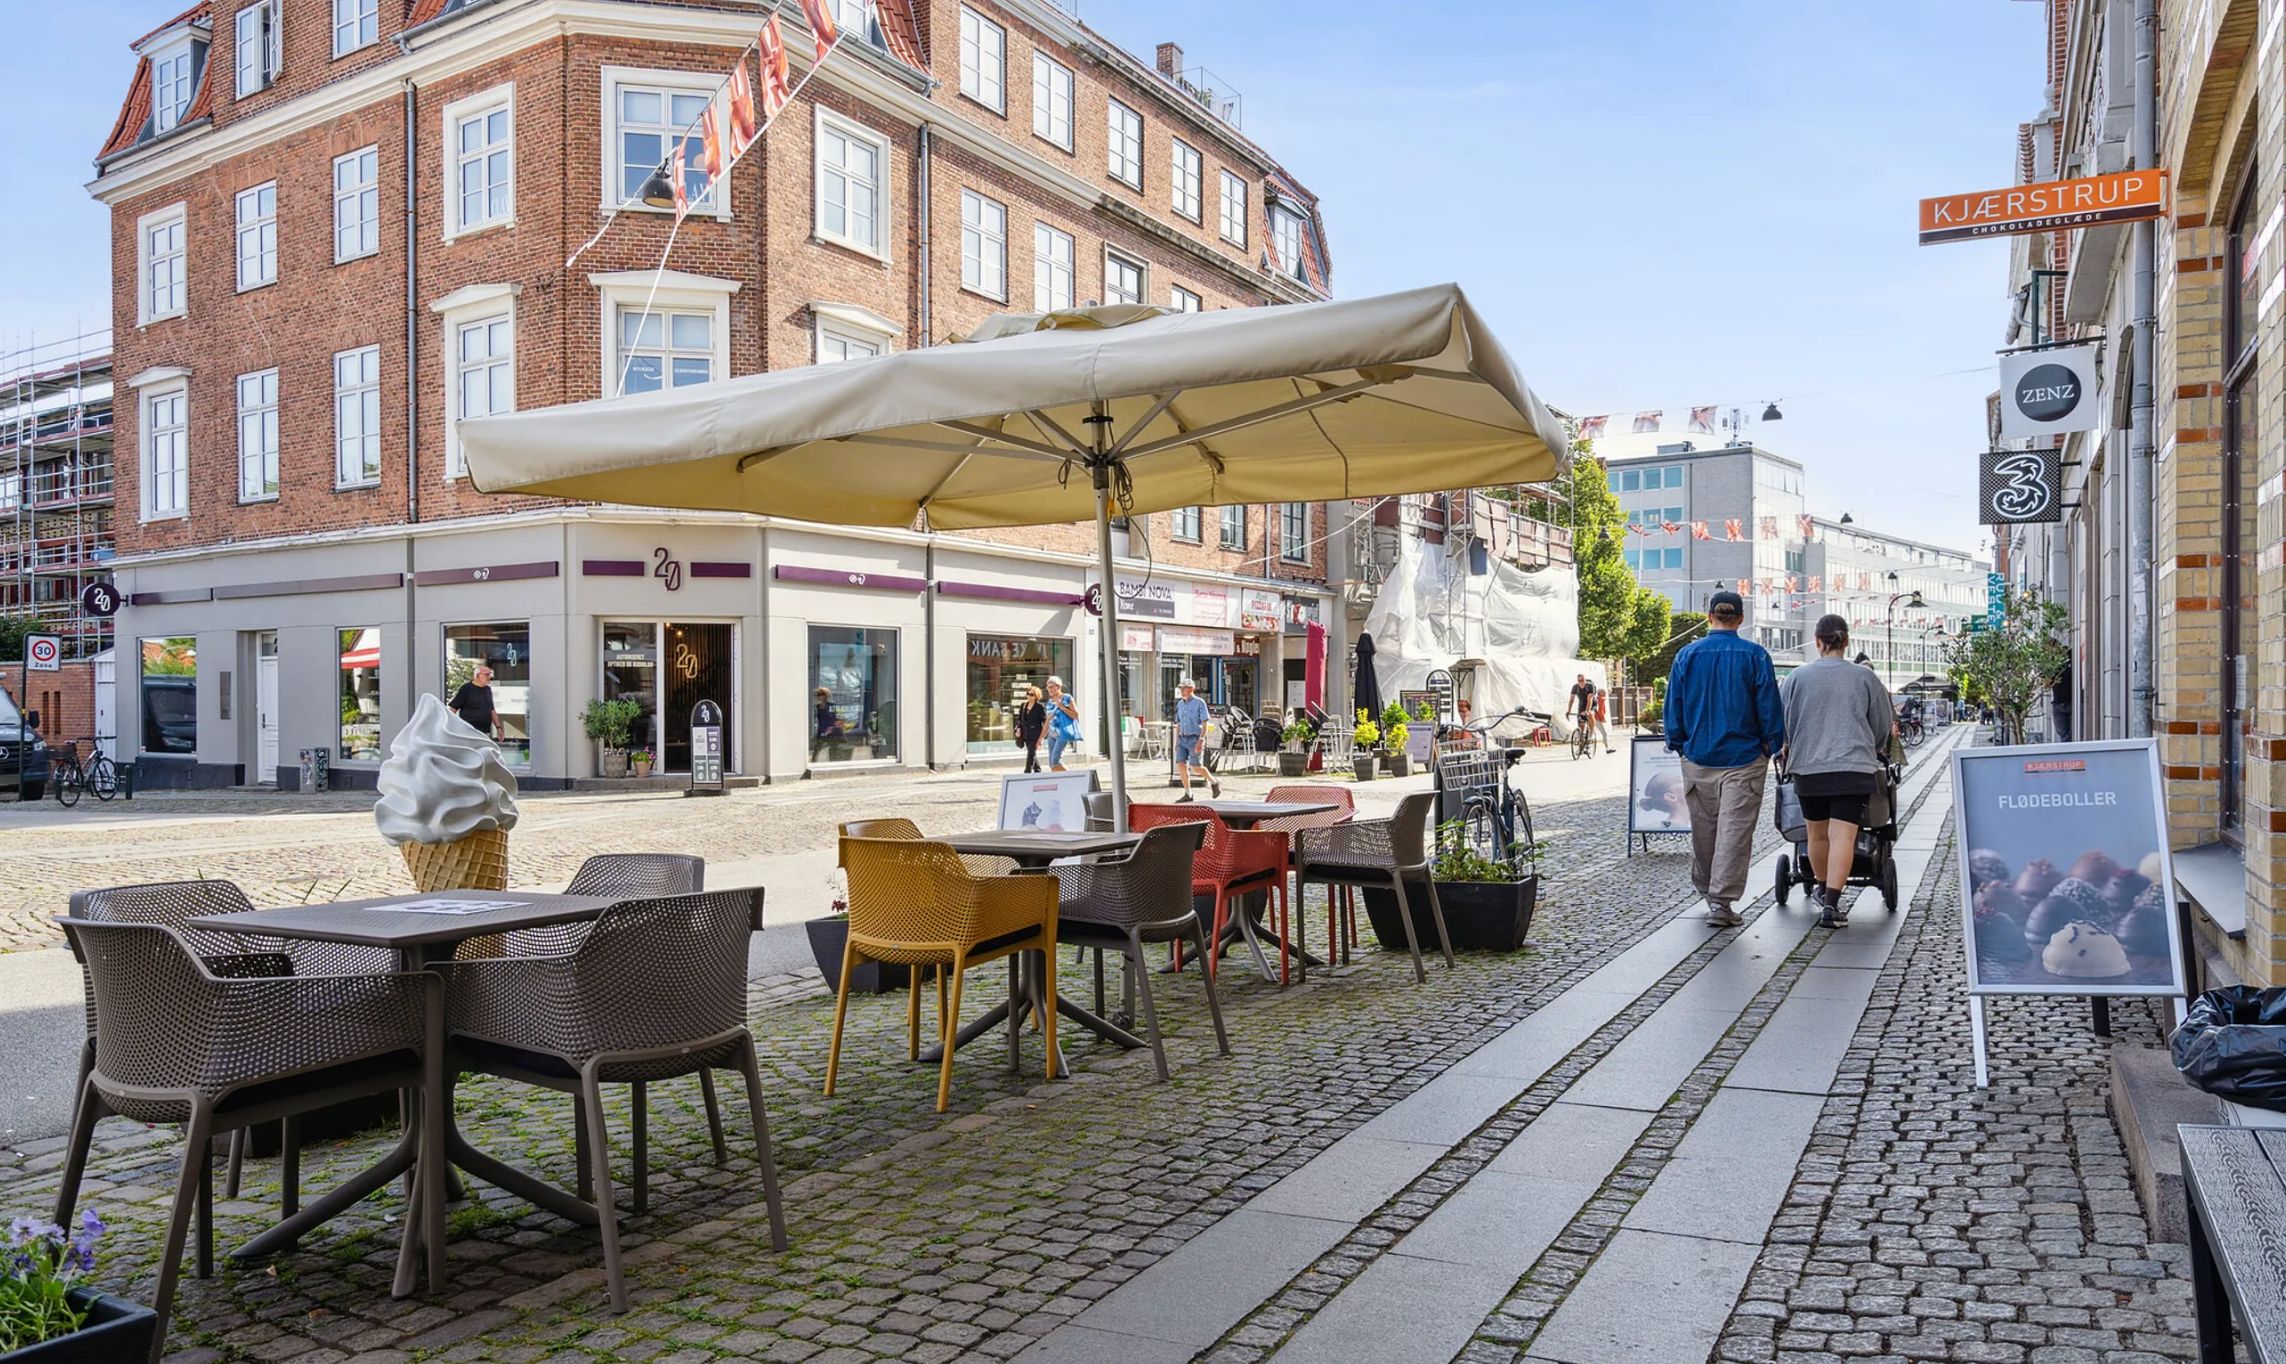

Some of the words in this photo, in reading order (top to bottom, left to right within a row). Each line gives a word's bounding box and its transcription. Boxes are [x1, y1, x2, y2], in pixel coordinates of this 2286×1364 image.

[1934, 177, 2143, 224] KJÆRSTRUP
[1972, 212, 2103, 235] CHOKOLADEGLÆDE
[2022, 384, 2075, 404] ZENZ
[1993, 454, 2050, 519] 3
[1149, 586, 1172, 600] NOVA
[36, 646, 52, 656] 30
[2027, 760, 2081, 770] KJÆRSTRUP
[1998, 791, 2117, 809] FLØDEBOLLER
